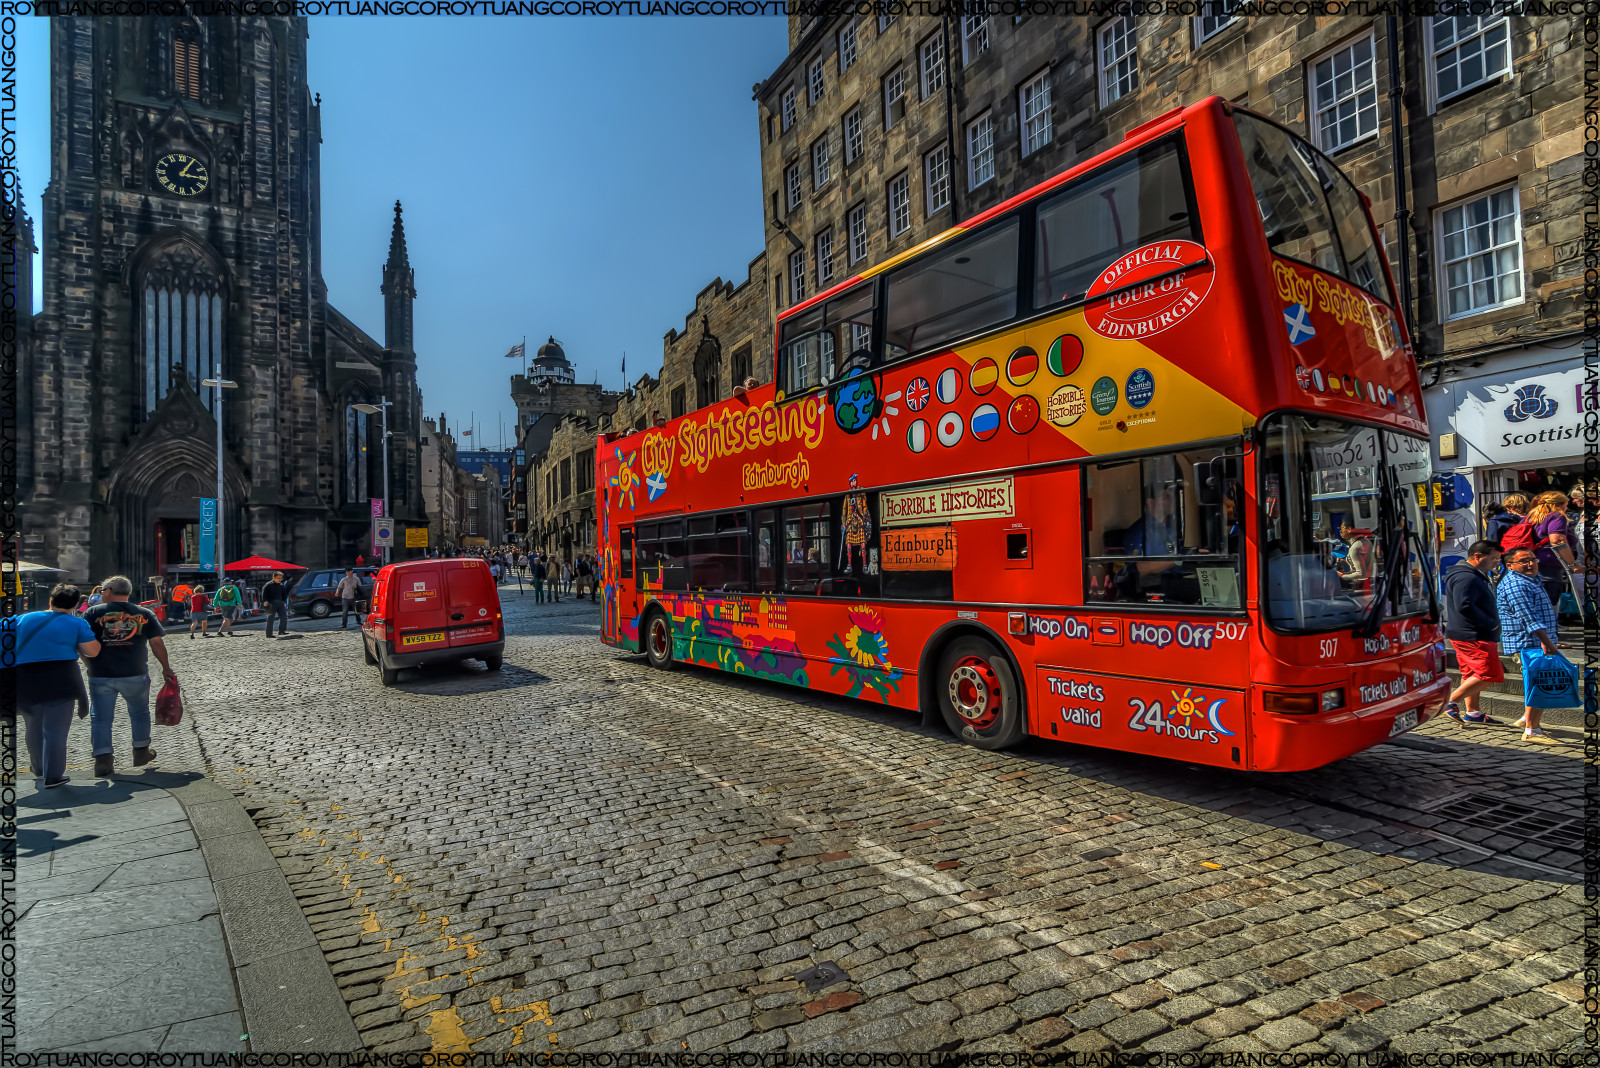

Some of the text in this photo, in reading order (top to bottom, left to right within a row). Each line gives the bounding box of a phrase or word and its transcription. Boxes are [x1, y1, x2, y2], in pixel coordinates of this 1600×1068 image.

[1103, 244, 1183, 284] OFFICIAL
[1106, 272, 1186, 309] TOUR OF
[1272, 260, 1313, 313] City
[1097, 291, 1201, 337] EDINBURGH
[1047, 388, 1085, 408] HORRIBLE
[1047, 402, 1087, 421] HISTORIES
[641, 390, 825, 478] City Sightseeing
[1126, 417, 1157, 427] EXCEPTIONAL
[742, 452, 810, 491] Edinburgh
[886, 487, 1006, 517] HORRIBLE HISTORIES
[202, 500, 214, 538] TICKETS
[884, 532, 953, 556] Edinburgh
[894, 554, 913, 567] Terry
[915, 553, 937, 566] Deary
[406, 590, 422, 598] Royal
[406, 633, 442, 644] WV58 TZZ
[1029, 616, 1062, 640] Hop
[1063, 614, 1090, 640] On
[1130, 621, 1171, 648] Hop
[1175, 621, 1216, 650] Off
[1215, 621, 1248, 641] 507
[1319, 638, 1338, 659] 507
[1047, 676, 1105, 703] Tickets
[1359, 669, 1434, 704] Tickets valid 24 hours
[1061, 705, 1102, 729] valid
[1128, 698, 1219, 744] 24 hours
